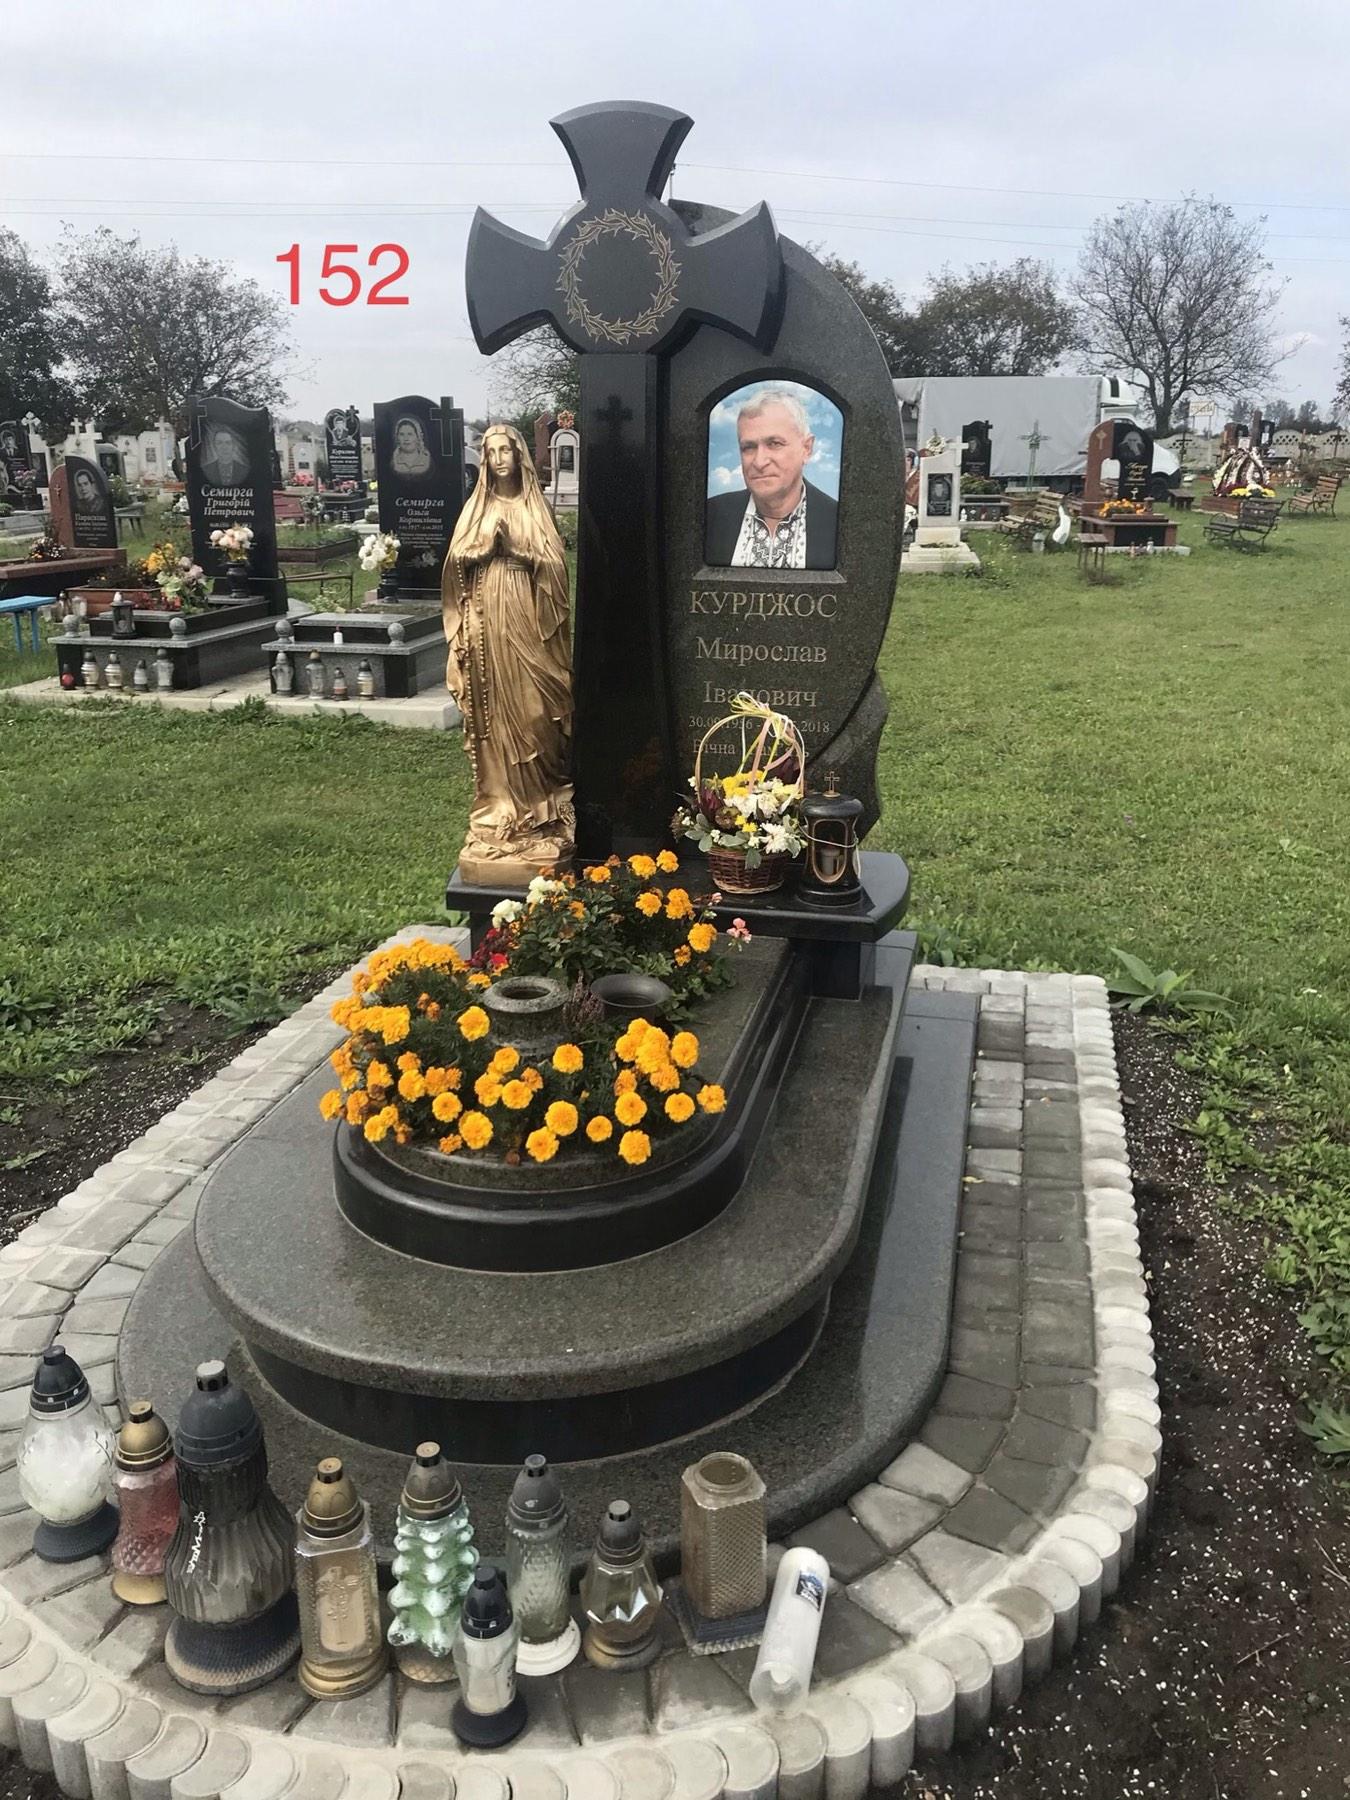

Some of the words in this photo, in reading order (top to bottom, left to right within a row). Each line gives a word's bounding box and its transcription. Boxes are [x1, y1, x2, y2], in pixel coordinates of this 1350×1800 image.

[201, 484, 254, 500] Семирга
[207, 498, 250, 508] Григорій
[395, 497, 445, 509] Семирга
[204, 507, 255, 518] Петрович
[689, 591, 838, 621] КУРДЖОС
[695, 636, 828, 666] Мирослав
